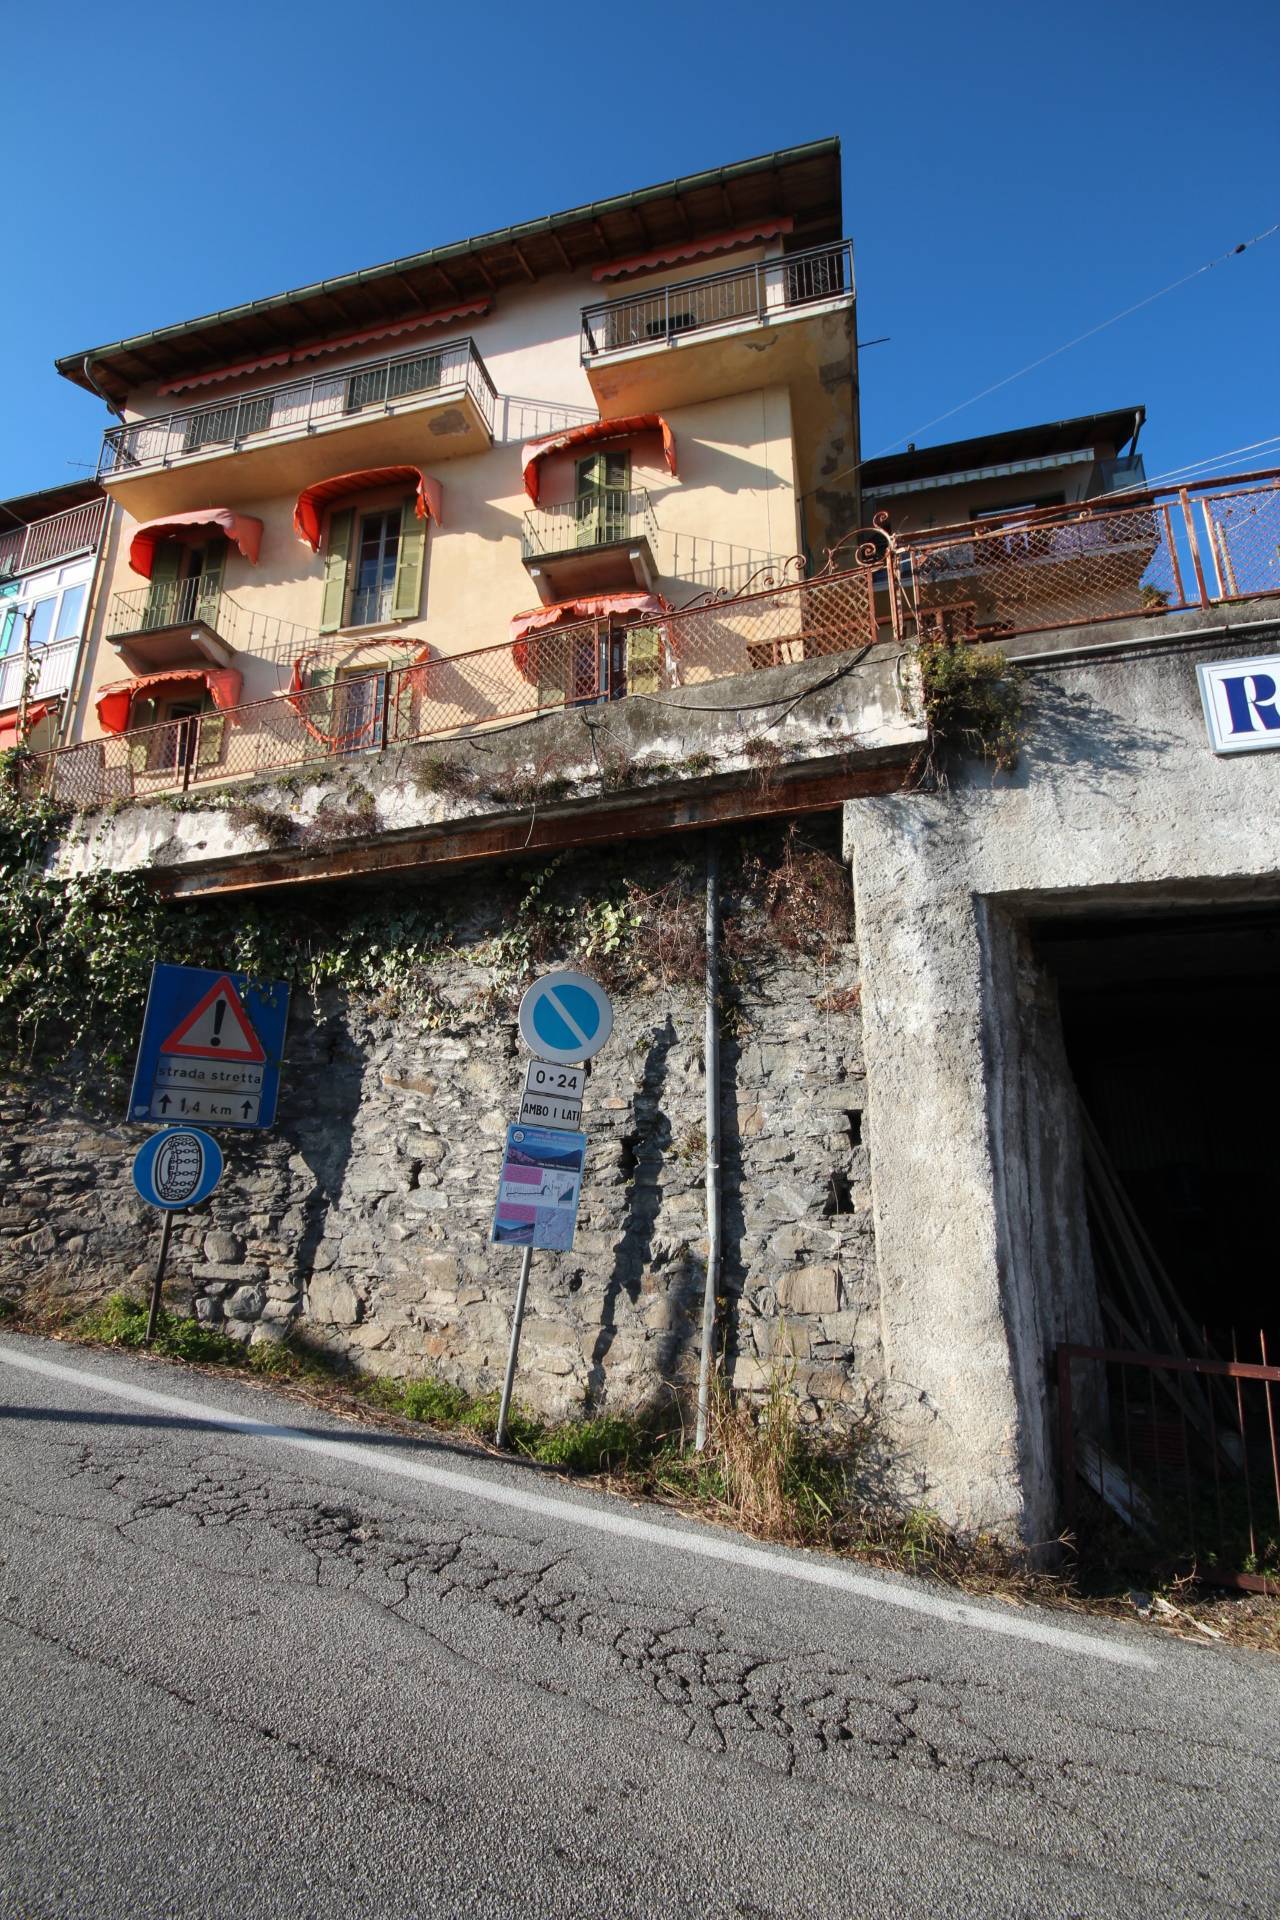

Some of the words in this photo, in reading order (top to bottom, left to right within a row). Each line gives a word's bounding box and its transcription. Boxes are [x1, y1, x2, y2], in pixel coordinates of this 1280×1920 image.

[158, 1066, 205, 1080] strada
[210, 1071, 261, 1084] stretta
[181, 1098, 200, 1115] 1,4
[210, 1103, 232, 1116] km
[523, 1103, 549, 1117] AMBO
[562, 1109, 580, 1121] LATI
